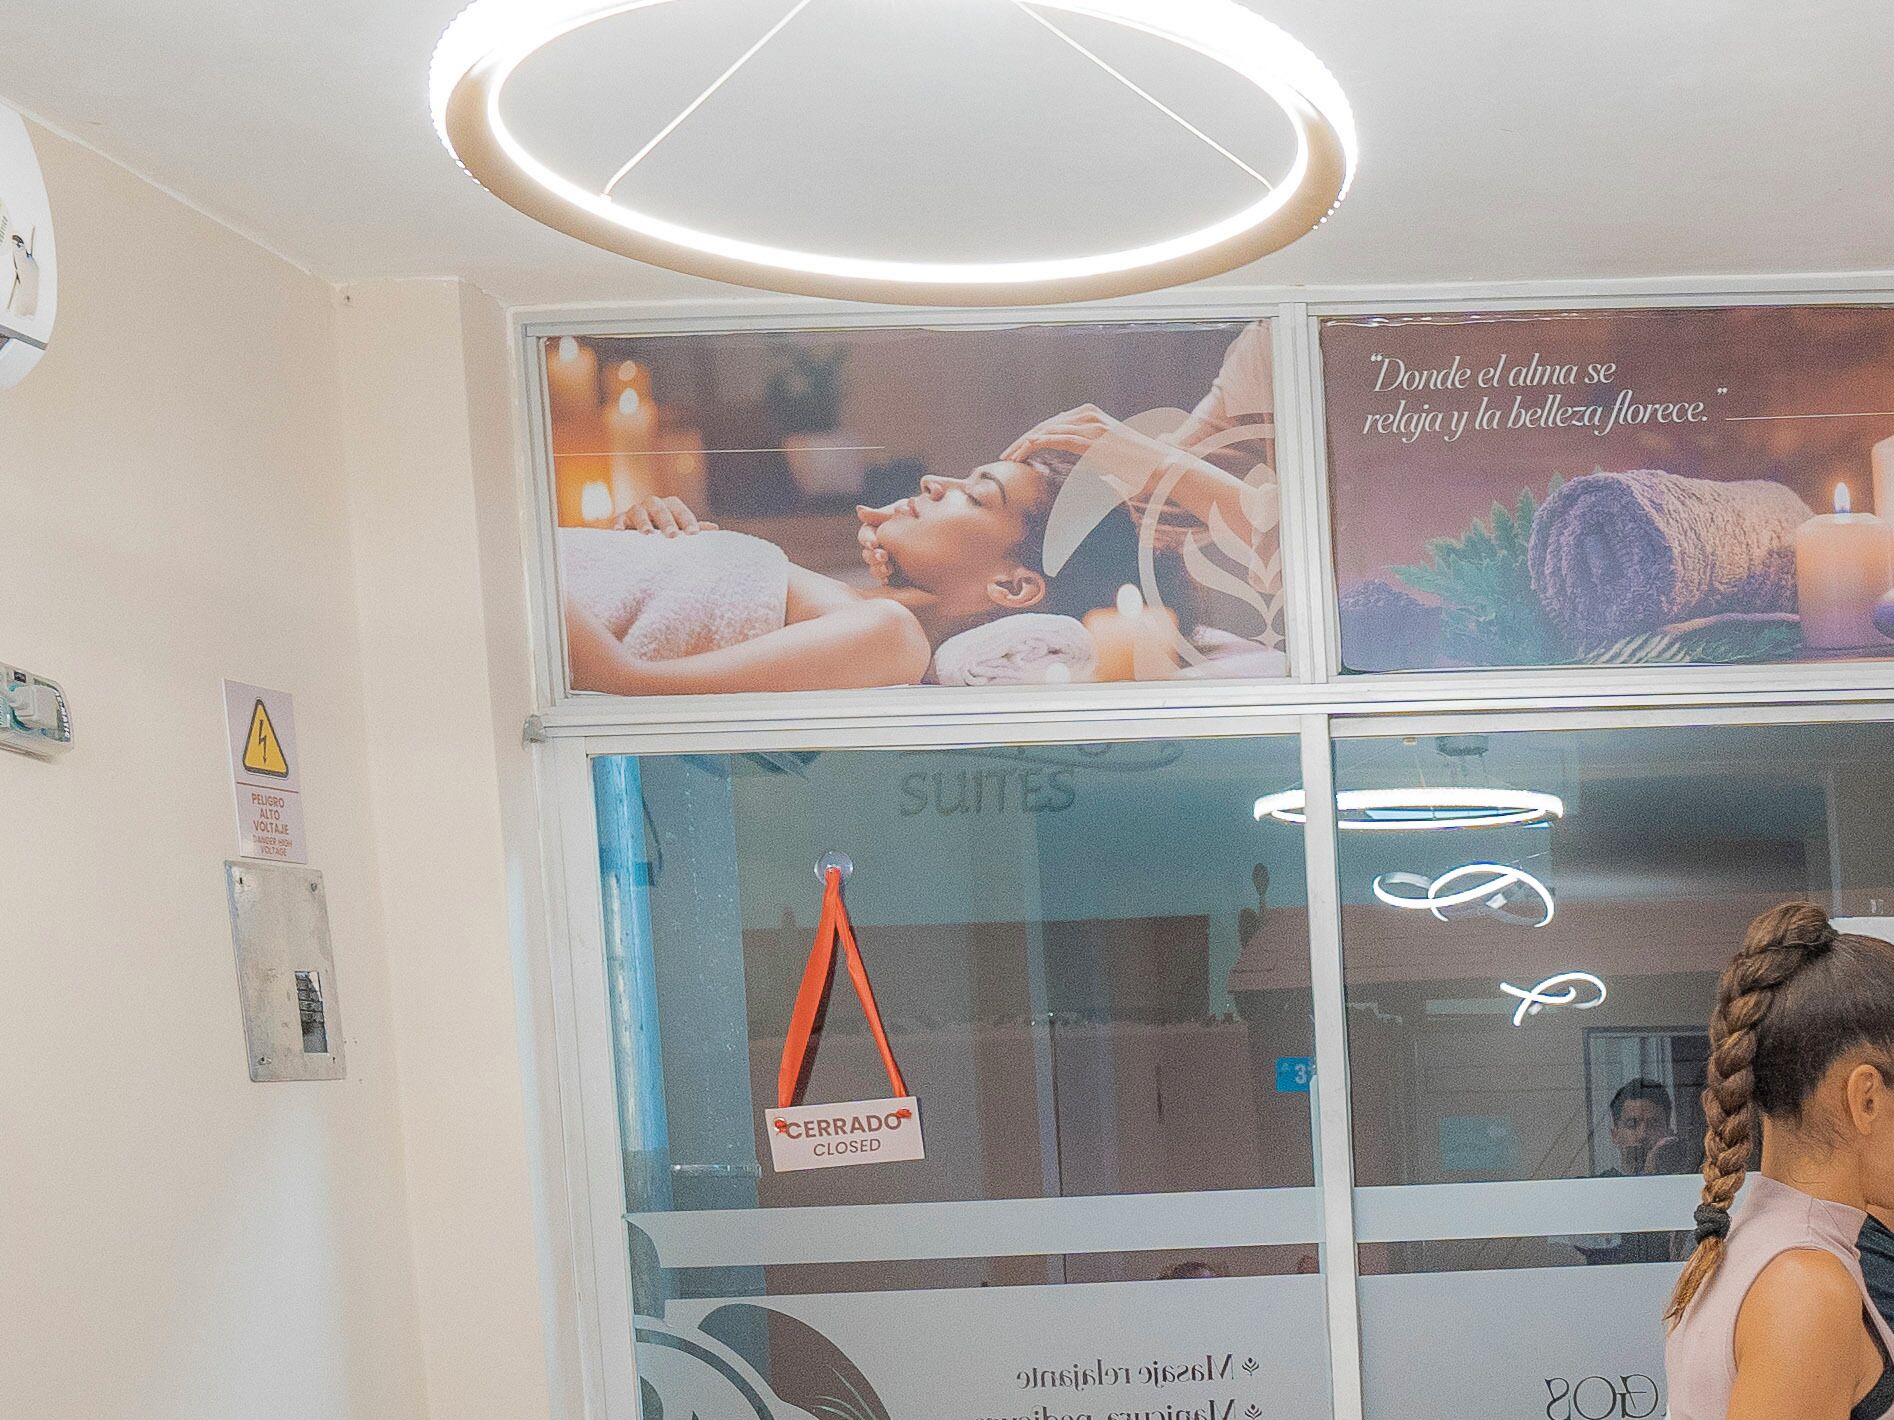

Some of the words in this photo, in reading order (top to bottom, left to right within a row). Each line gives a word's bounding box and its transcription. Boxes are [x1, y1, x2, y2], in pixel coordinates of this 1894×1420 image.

[1477, 354, 1506, 388] el
[1508, 353, 1576, 387] alma
[1584, 361, 1616, 385] se
[1363, 399, 1444, 445] relaja
[1445, 405, 1470, 443] y
[1474, 397, 1502, 430] la
[1507, 392, 1604, 436] belleza
[251, 793, 285, 808] PELIGRO
[899, 767, 1077, 817] SUITES
[260, 808, 280, 820] ALTO
[252, 820, 289, 835] VOLTAJE
[261, 846, 287, 857] VOLTAGE
[785, 1113, 902, 1140] CERRADO
[813, 1139, 881, 1157] CLOSED
